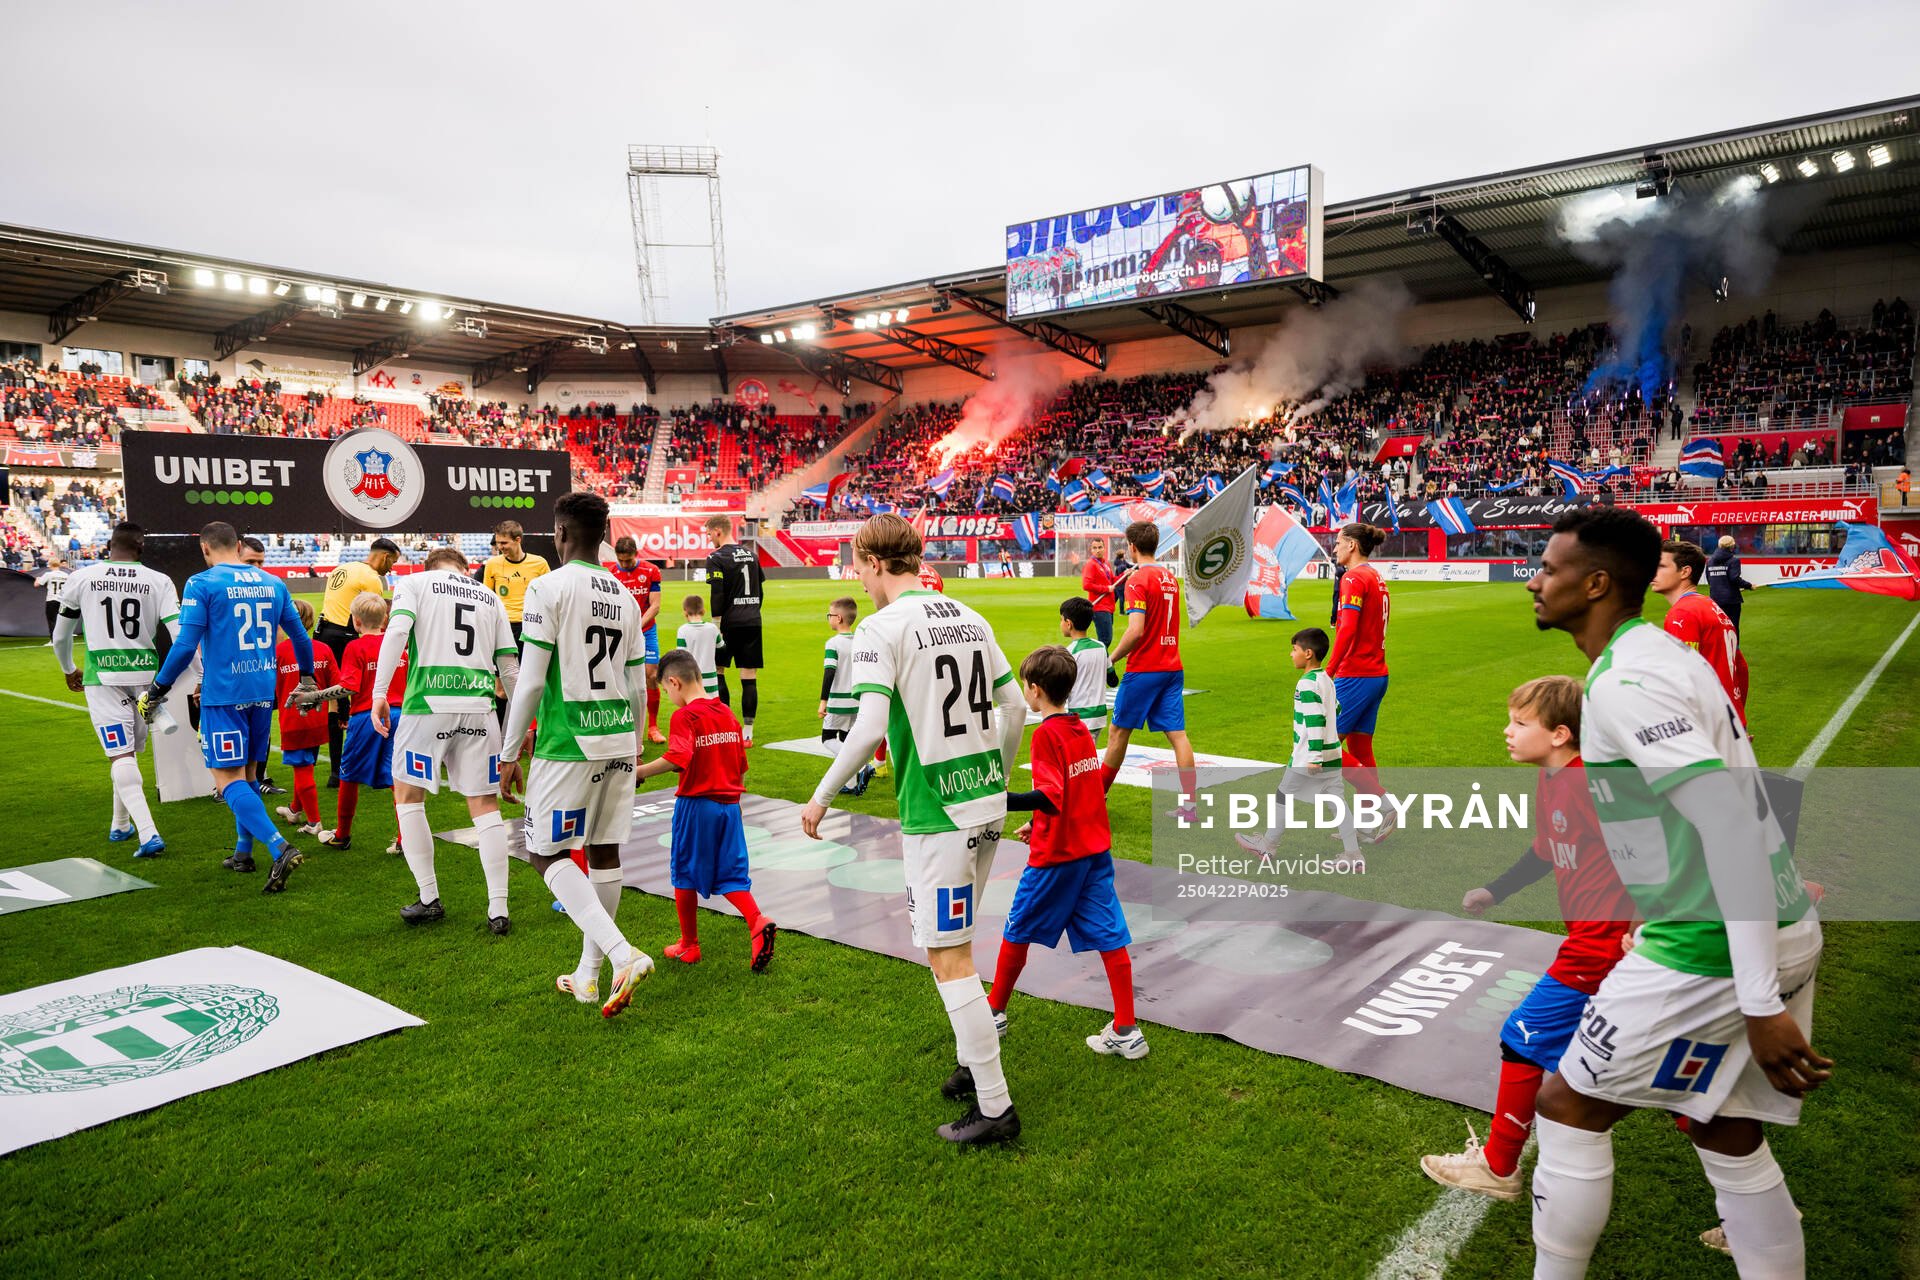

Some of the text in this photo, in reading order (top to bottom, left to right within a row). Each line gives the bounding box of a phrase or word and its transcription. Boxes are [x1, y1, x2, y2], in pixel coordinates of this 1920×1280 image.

[1136, 271, 1167, 284] röda
[1168, 265, 1195, 279] och
[1198, 259, 1220, 275] blå
[153, 455, 296, 487] UNIBET
[447, 466, 552, 493] UNIBET
[1483, 498, 1579, 518] Sverker
[957, 516, 998, 536] 1985
[105, 567, 137, 578] ABB
[234, 571, 262, 582] ABB
[448, 573, 481, 587] ABB
[591, 576, 620, 595] ABB
[741, 564, 751, 595] 1
[90, 580, 151, 595] NSABIYUMVA
[226, 585, 276, 600] BERNARDINI
[432, 582, 495, 608] GUNNARSSON
[100, 596, 141, 640] 18
[922, 602, 961, 619] ABB
[1163, 592, 1174, 636] 7
[233, 602, 273, 651] 25
[454, 602, 476, 656] 5
[914, 623, 988, 650] J. JOHANSSON
[585, 625, 623, 690] 27
[935, 650, 993, 738] 24
[1635, 715, 1694, 747] VÄSTERÅS
[1342, 941, 1505, 1036] UNIBET
